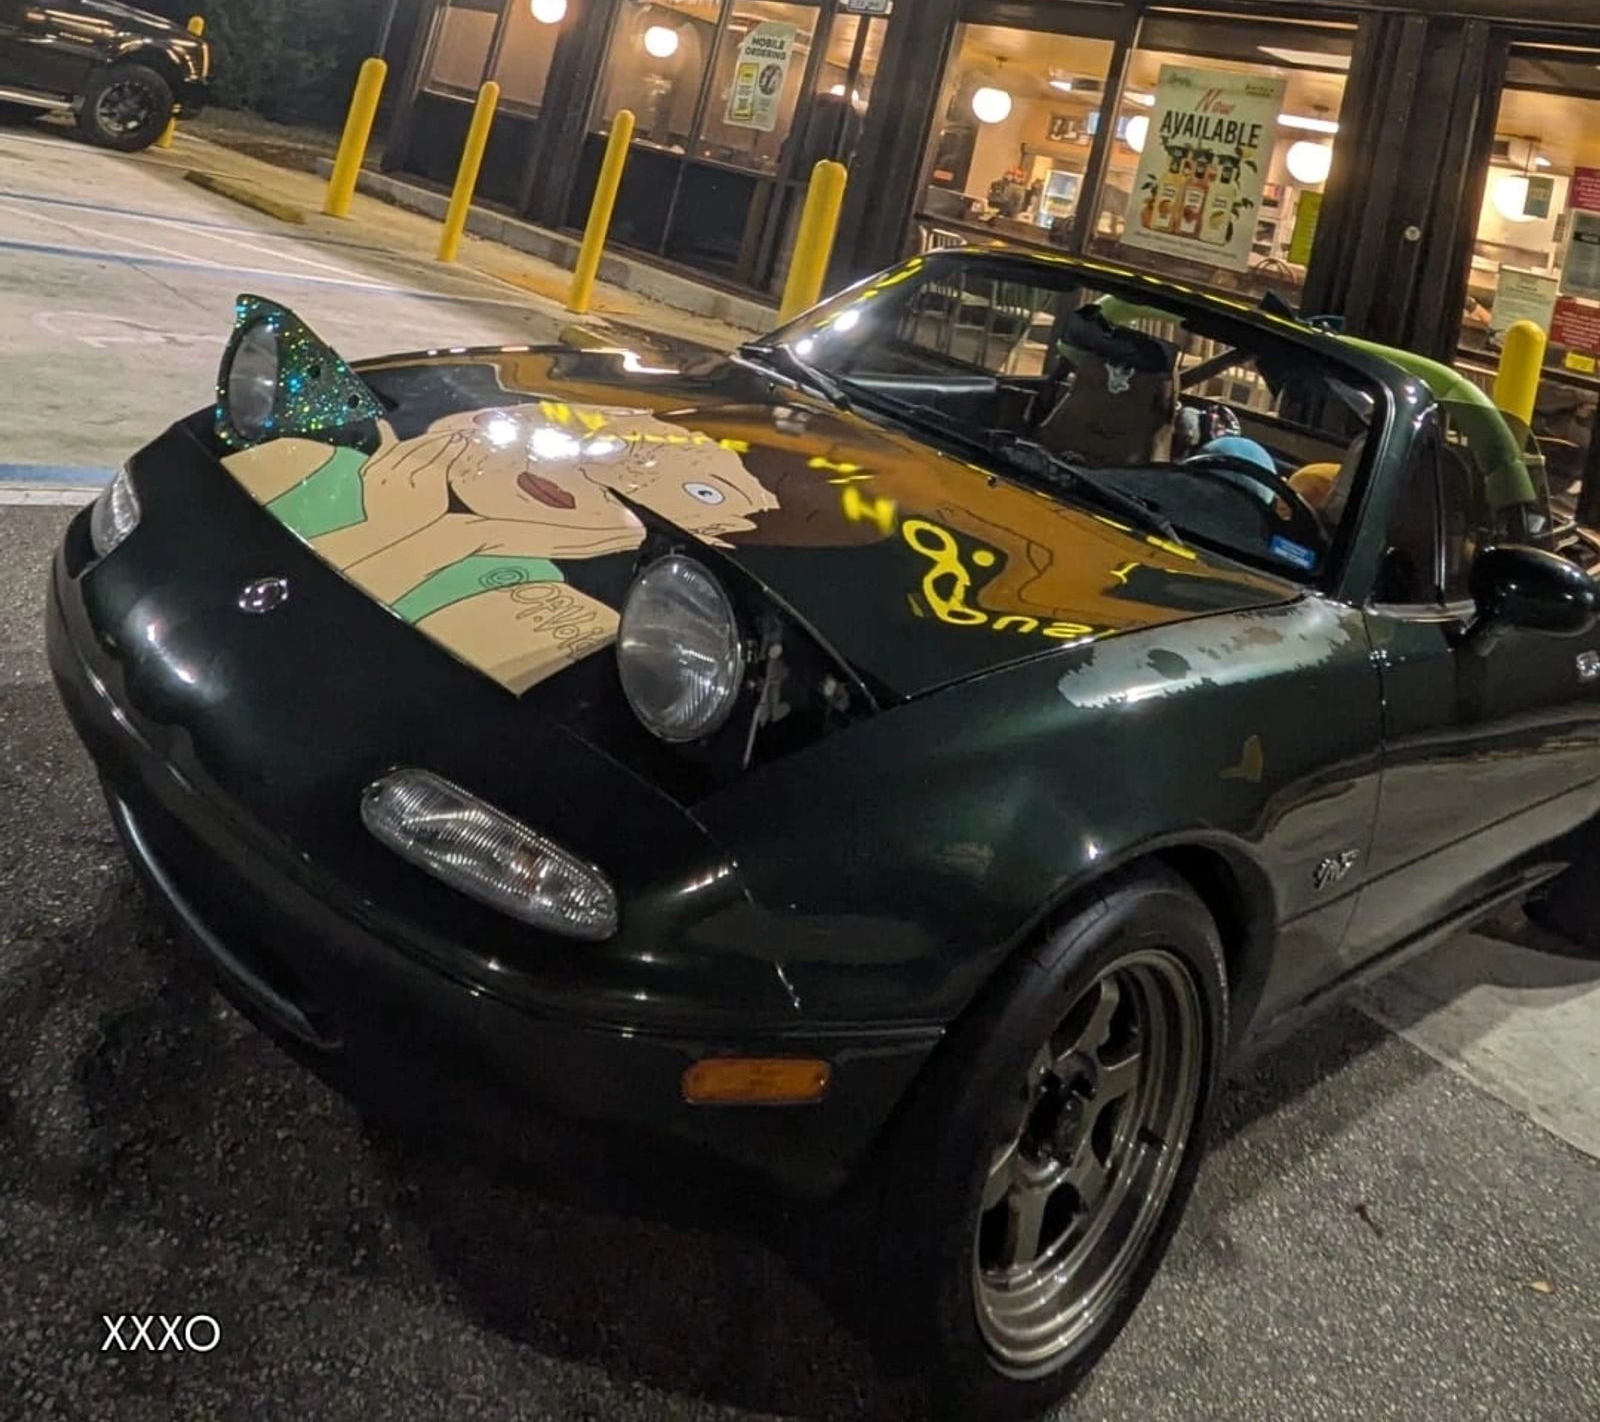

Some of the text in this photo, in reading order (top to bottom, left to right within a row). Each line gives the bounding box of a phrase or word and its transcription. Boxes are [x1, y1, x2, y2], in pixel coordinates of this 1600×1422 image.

[752, 37, 786, 51] MOBILE
[745, 46, 787, 61] ORDERING
[1159, 110, 1263, 149] AVAILABLE
